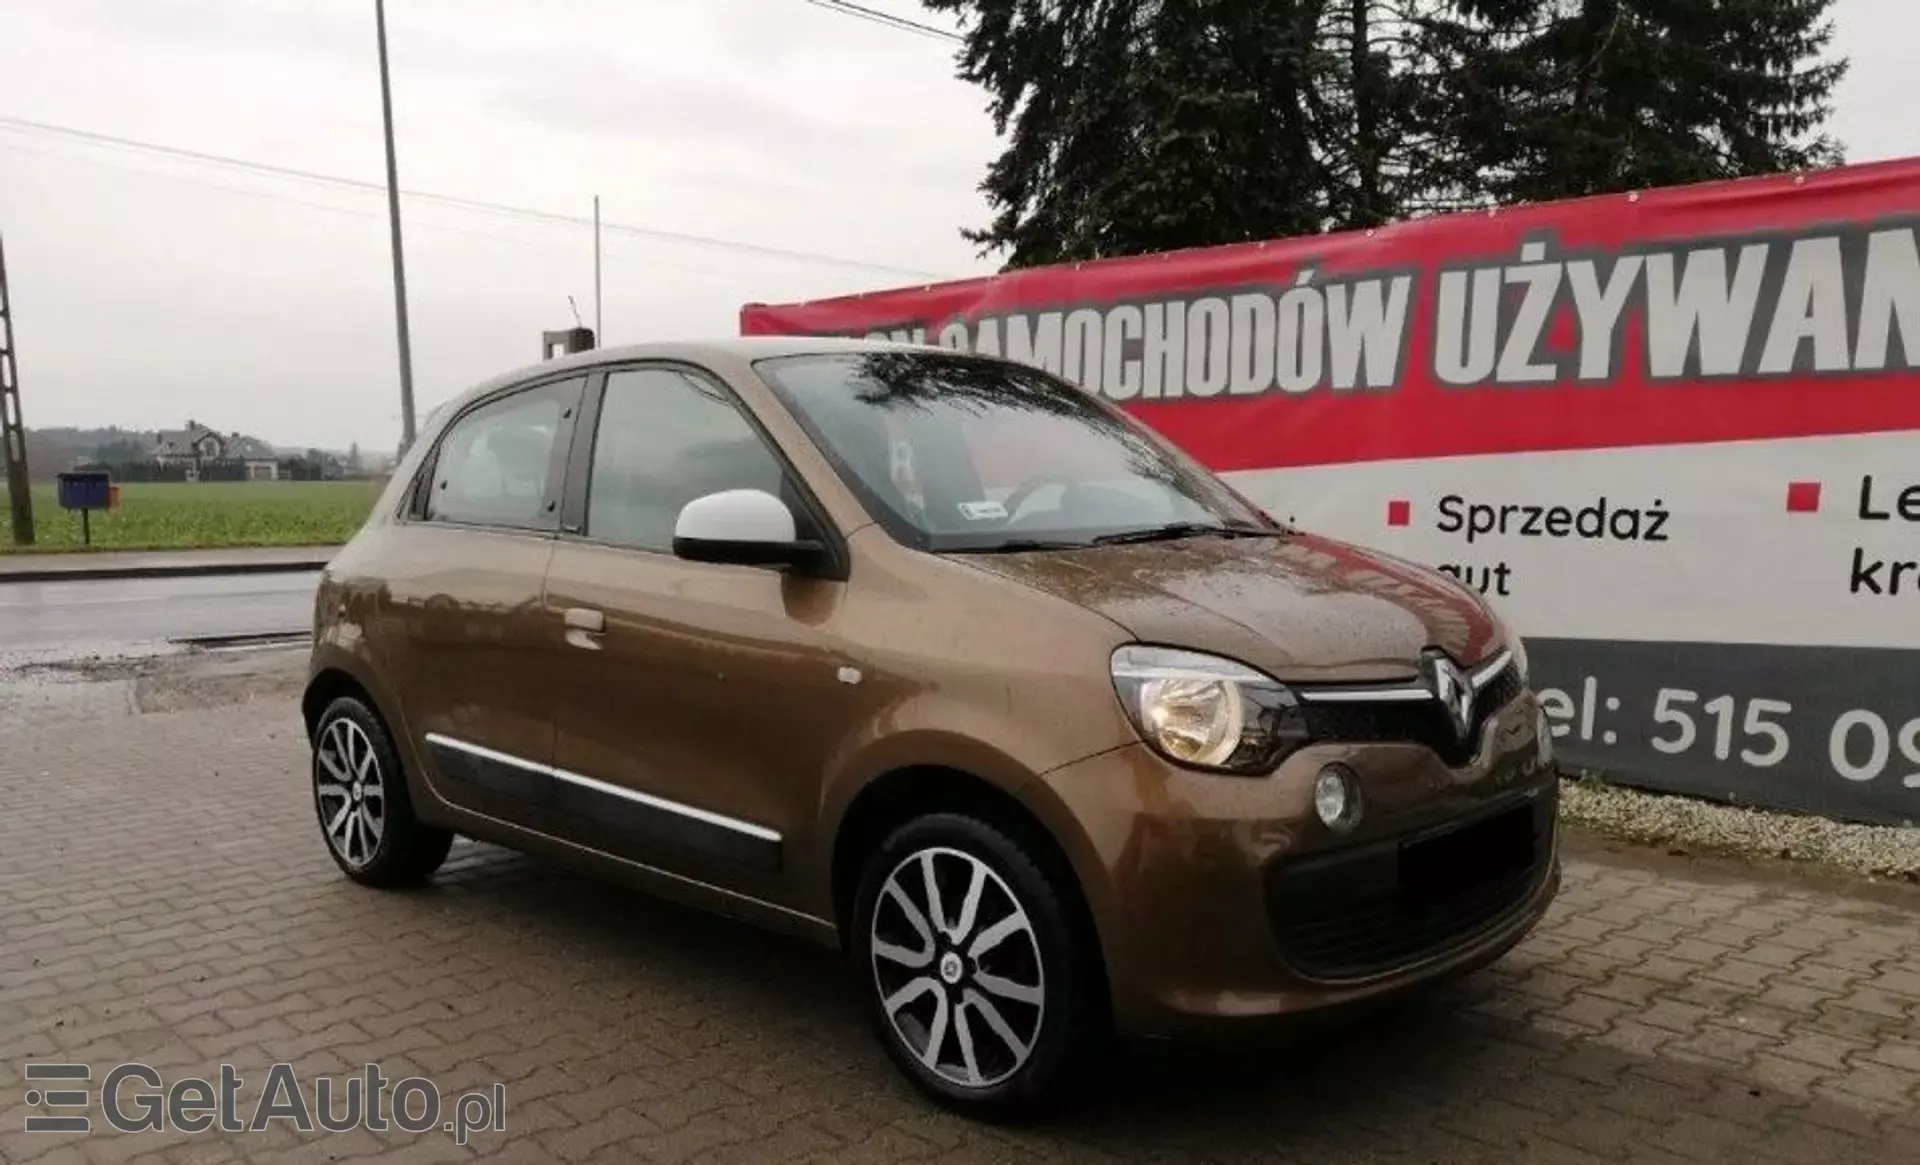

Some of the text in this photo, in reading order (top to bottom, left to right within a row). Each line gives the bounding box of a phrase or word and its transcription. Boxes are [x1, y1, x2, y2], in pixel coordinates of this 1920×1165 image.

[1436, 496, 1670, 542] Sprzedaż
[1859, 474, 1920, 521] Le
[1850, 547, 1920, 595] kr
[1651, 687, 1791, 767] 515
